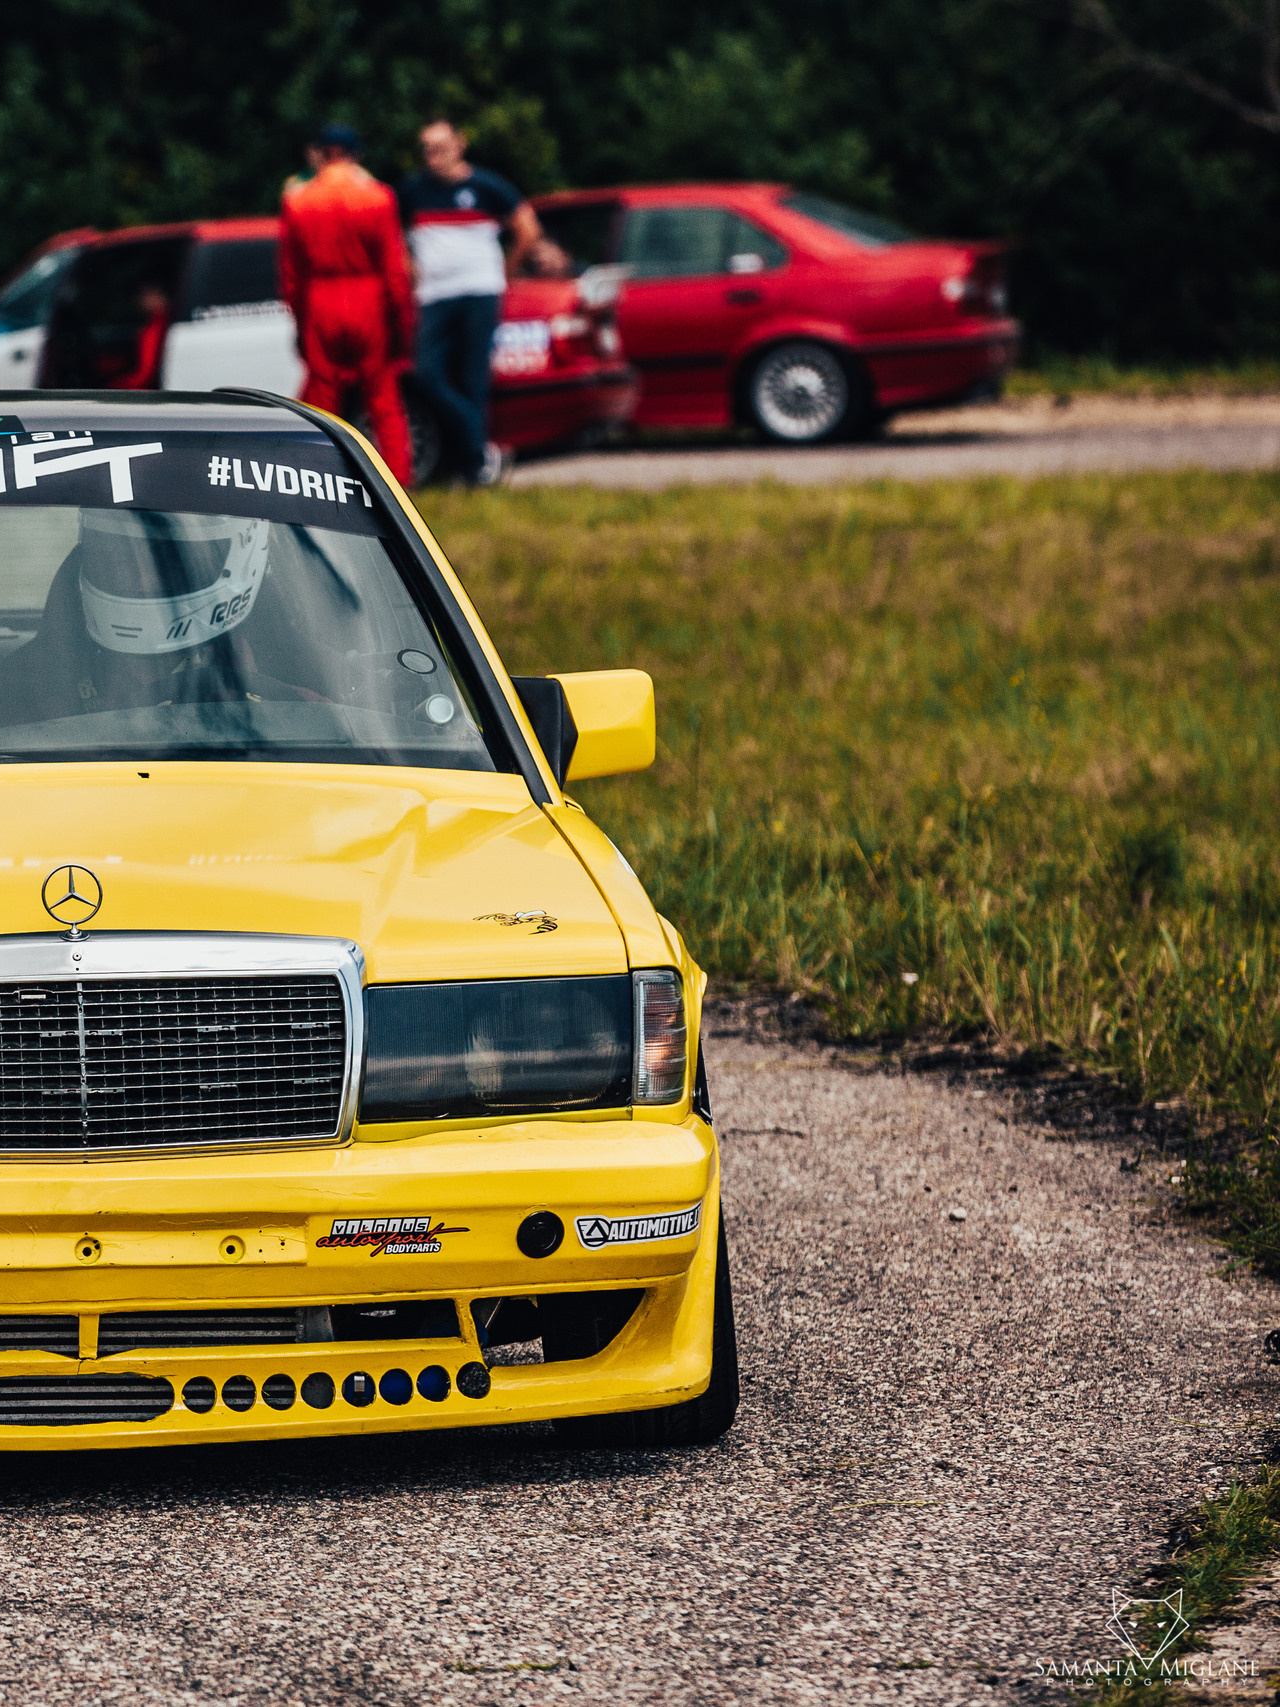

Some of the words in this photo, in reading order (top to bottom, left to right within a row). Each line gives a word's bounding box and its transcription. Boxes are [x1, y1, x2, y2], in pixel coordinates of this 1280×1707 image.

[209, 586, 253, 626] RRS
[331, 1218, 430, 1235] VILNIUS
[317, 1223, 470, 1256] autosport
[385, 1243, 441, 1254] BODYPARTS
